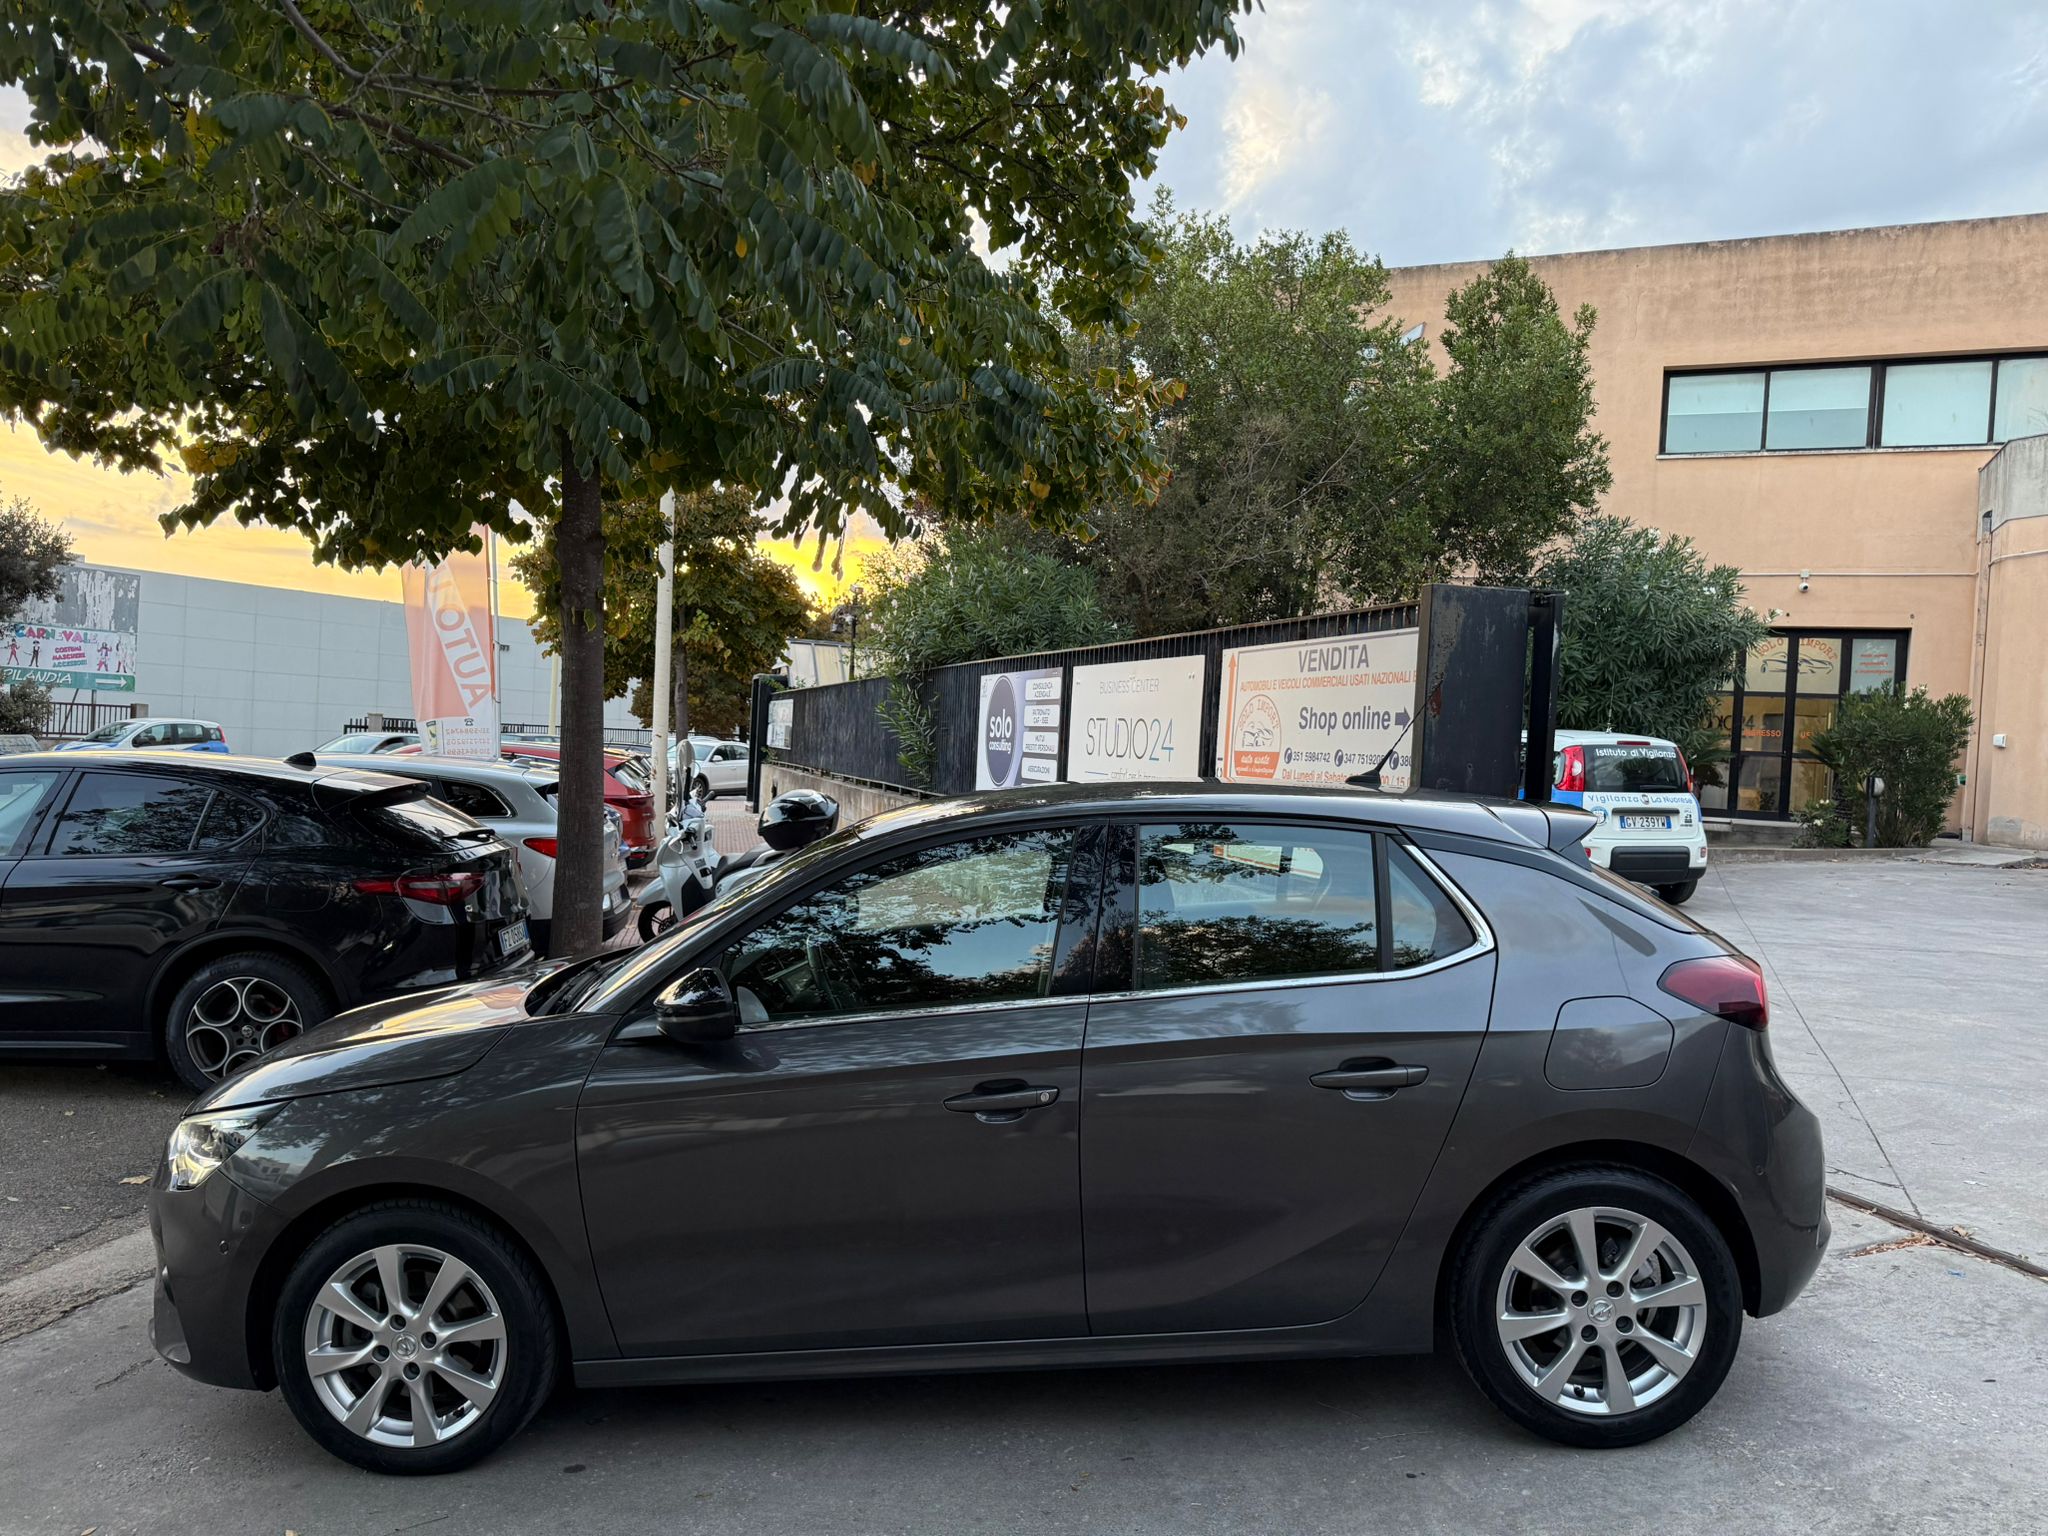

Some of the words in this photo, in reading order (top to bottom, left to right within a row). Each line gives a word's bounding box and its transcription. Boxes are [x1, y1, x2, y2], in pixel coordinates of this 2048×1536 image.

[14, 624, 98, 644] CARNEVALE
[1299, 644, 1369, 672] VENDITA
[1800, 638, 1838, 661] IMPORT
[1100, 680, 1129, 694] BUSINESS
[1132, 678, 1160, 693] CENTER
[1240, 678, 1271, 692] AUTOMOBILI
[1272, 679, 1278, 690] E
[1279, 678, 1301, 690] VEICOLI
[1302, 675, 1348, 689] COMMERCIALI
[1349, 673, 1370, 686] USATI
[1371, 671, 1410, 685] NAZIONALI
[989, 708, 1012, 738] solo
[1299, 706, 1336, 735] Shop
[1342, 706, 1391, 730] online
[988, 739, 1012, 754] consulting
[1086, 717, 1174, 762] STUDIO24
[1293, 752, 1304, 762] 351
[1305, 752, 1331, 763] 5984742
[1344, 754, 1356, 764] 347
[1596, 748, 1627, 757] Istituto
[1630, 748, 1639, 757] di
[1639, 748, 1677, 759] Vigilanza
[1588, 795, 1639, 804] Vigilanza
[1663, 796, 1693, 805] Nuorese
